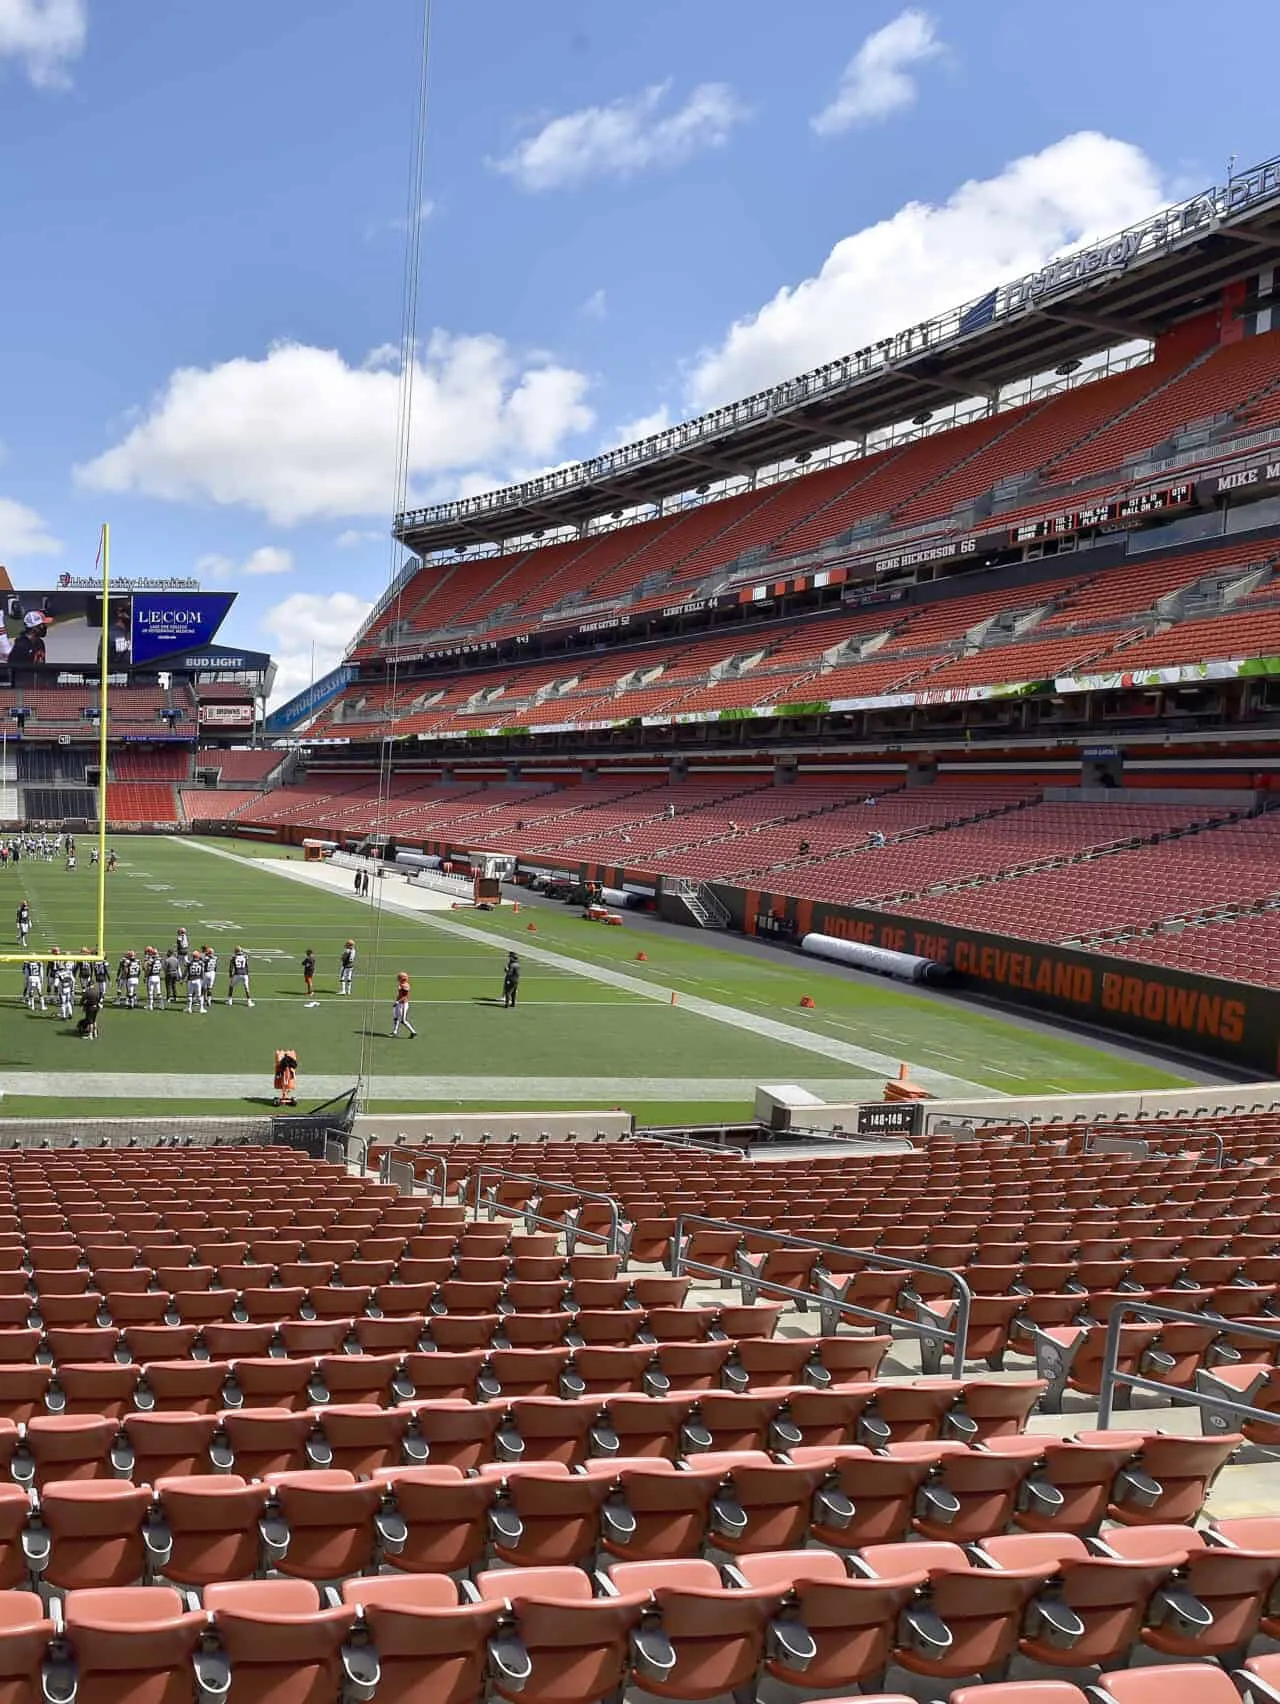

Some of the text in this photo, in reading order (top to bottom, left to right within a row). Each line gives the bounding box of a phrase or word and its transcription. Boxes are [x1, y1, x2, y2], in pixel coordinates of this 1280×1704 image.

[1218, 469, 1258, 492] MIKE
[876, 539, 976, 571] GENE HICKERSON 66
[707, 597, 718, 609] 44
[185, 658, 243, 667] BUD LIGHT
[30, 965, 39, 975] 12
[913, 932, 949, 962] THE
[954, 941, 1095, 1004] CLEVELAND
[1102, 973, 1246, 1042] BROWNS
